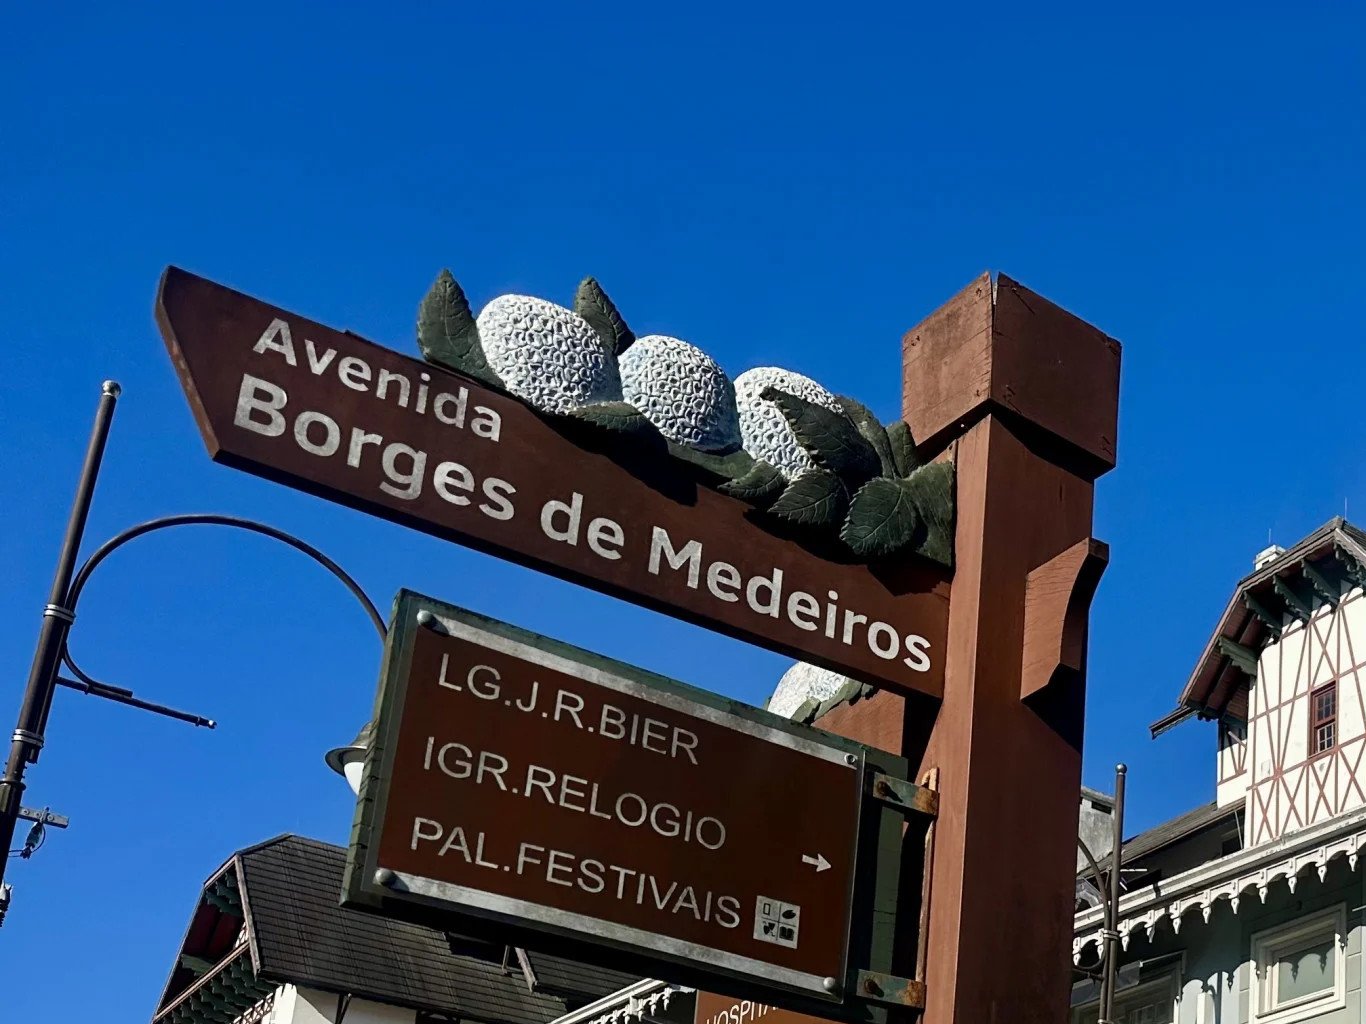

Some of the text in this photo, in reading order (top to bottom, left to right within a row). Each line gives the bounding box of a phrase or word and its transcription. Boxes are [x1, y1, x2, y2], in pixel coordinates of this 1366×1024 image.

[252, 317, 504, 443] Avenida
[233, 373, 933, 673] Borges de Medeiros
[438, 653, 700, 766] LG.J.R.BIER
[423, 736, 727, 851] IGR.RELOGIO
[410, 818, 741, 930] PAL.FESTIVAIS
